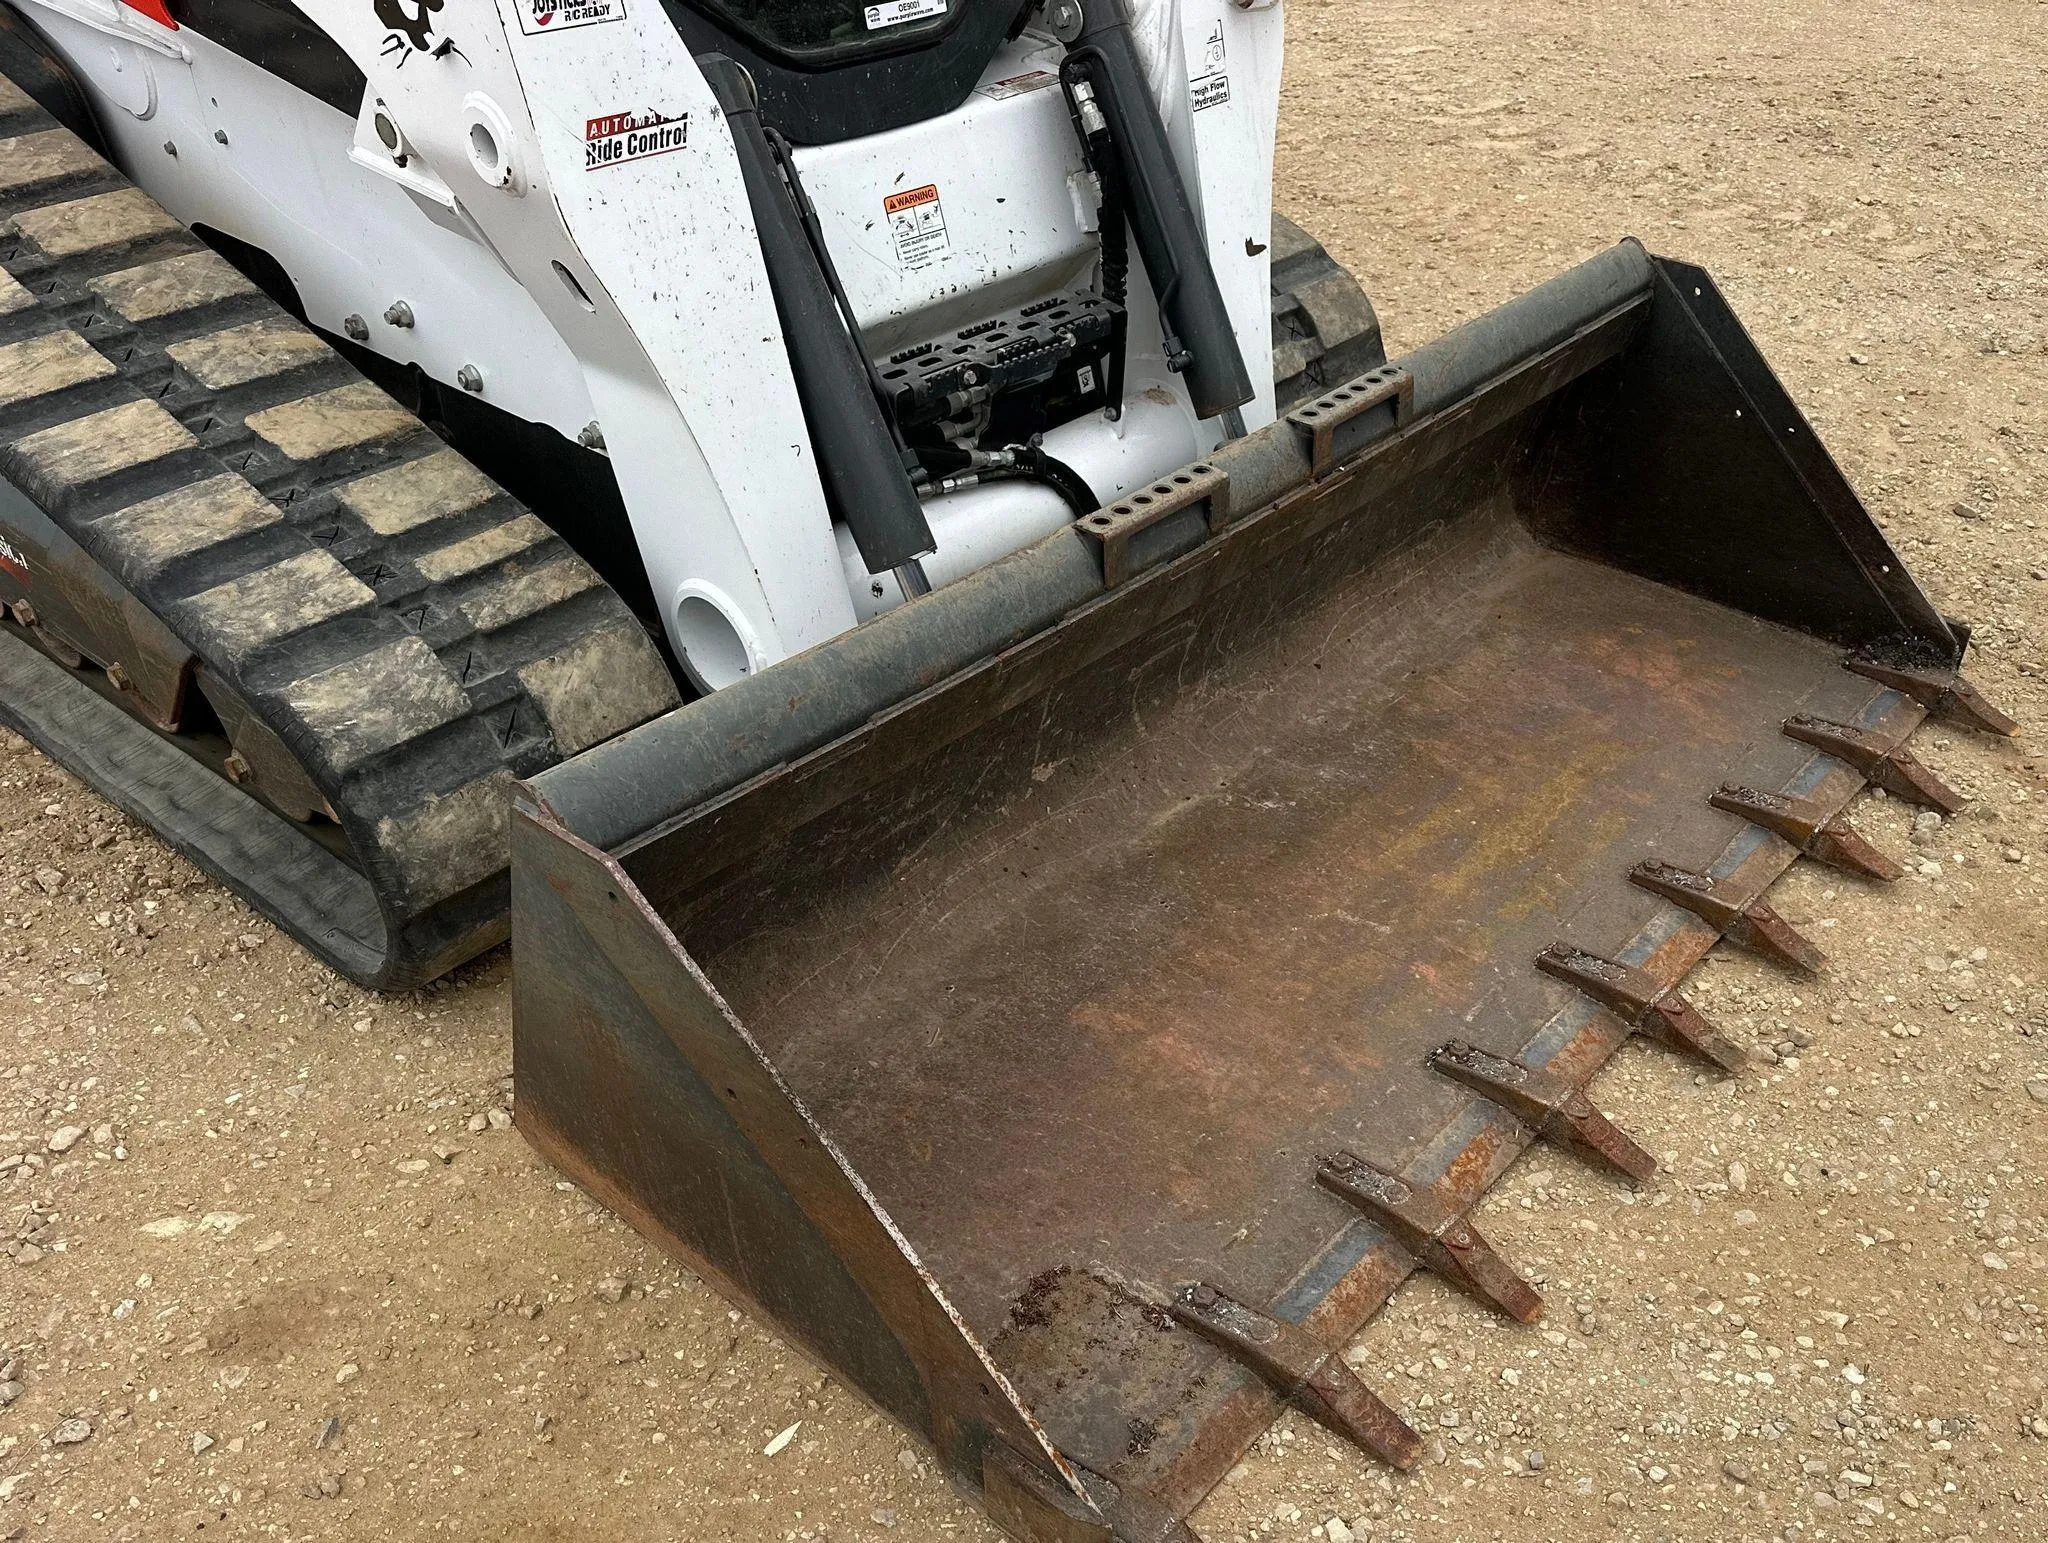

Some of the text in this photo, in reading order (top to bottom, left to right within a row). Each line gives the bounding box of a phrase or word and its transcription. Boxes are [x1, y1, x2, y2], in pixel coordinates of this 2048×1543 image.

[582, 4, 610, 19] READY
[1210, 81, 1225, 91] Flow
[1194, 91, 1228, 108] Hydraulics
[590, 110, 669, 137] AUTOMA
[586, 121, 687, 166] Ride Control
[896, 189, 934, 207] WARNING
